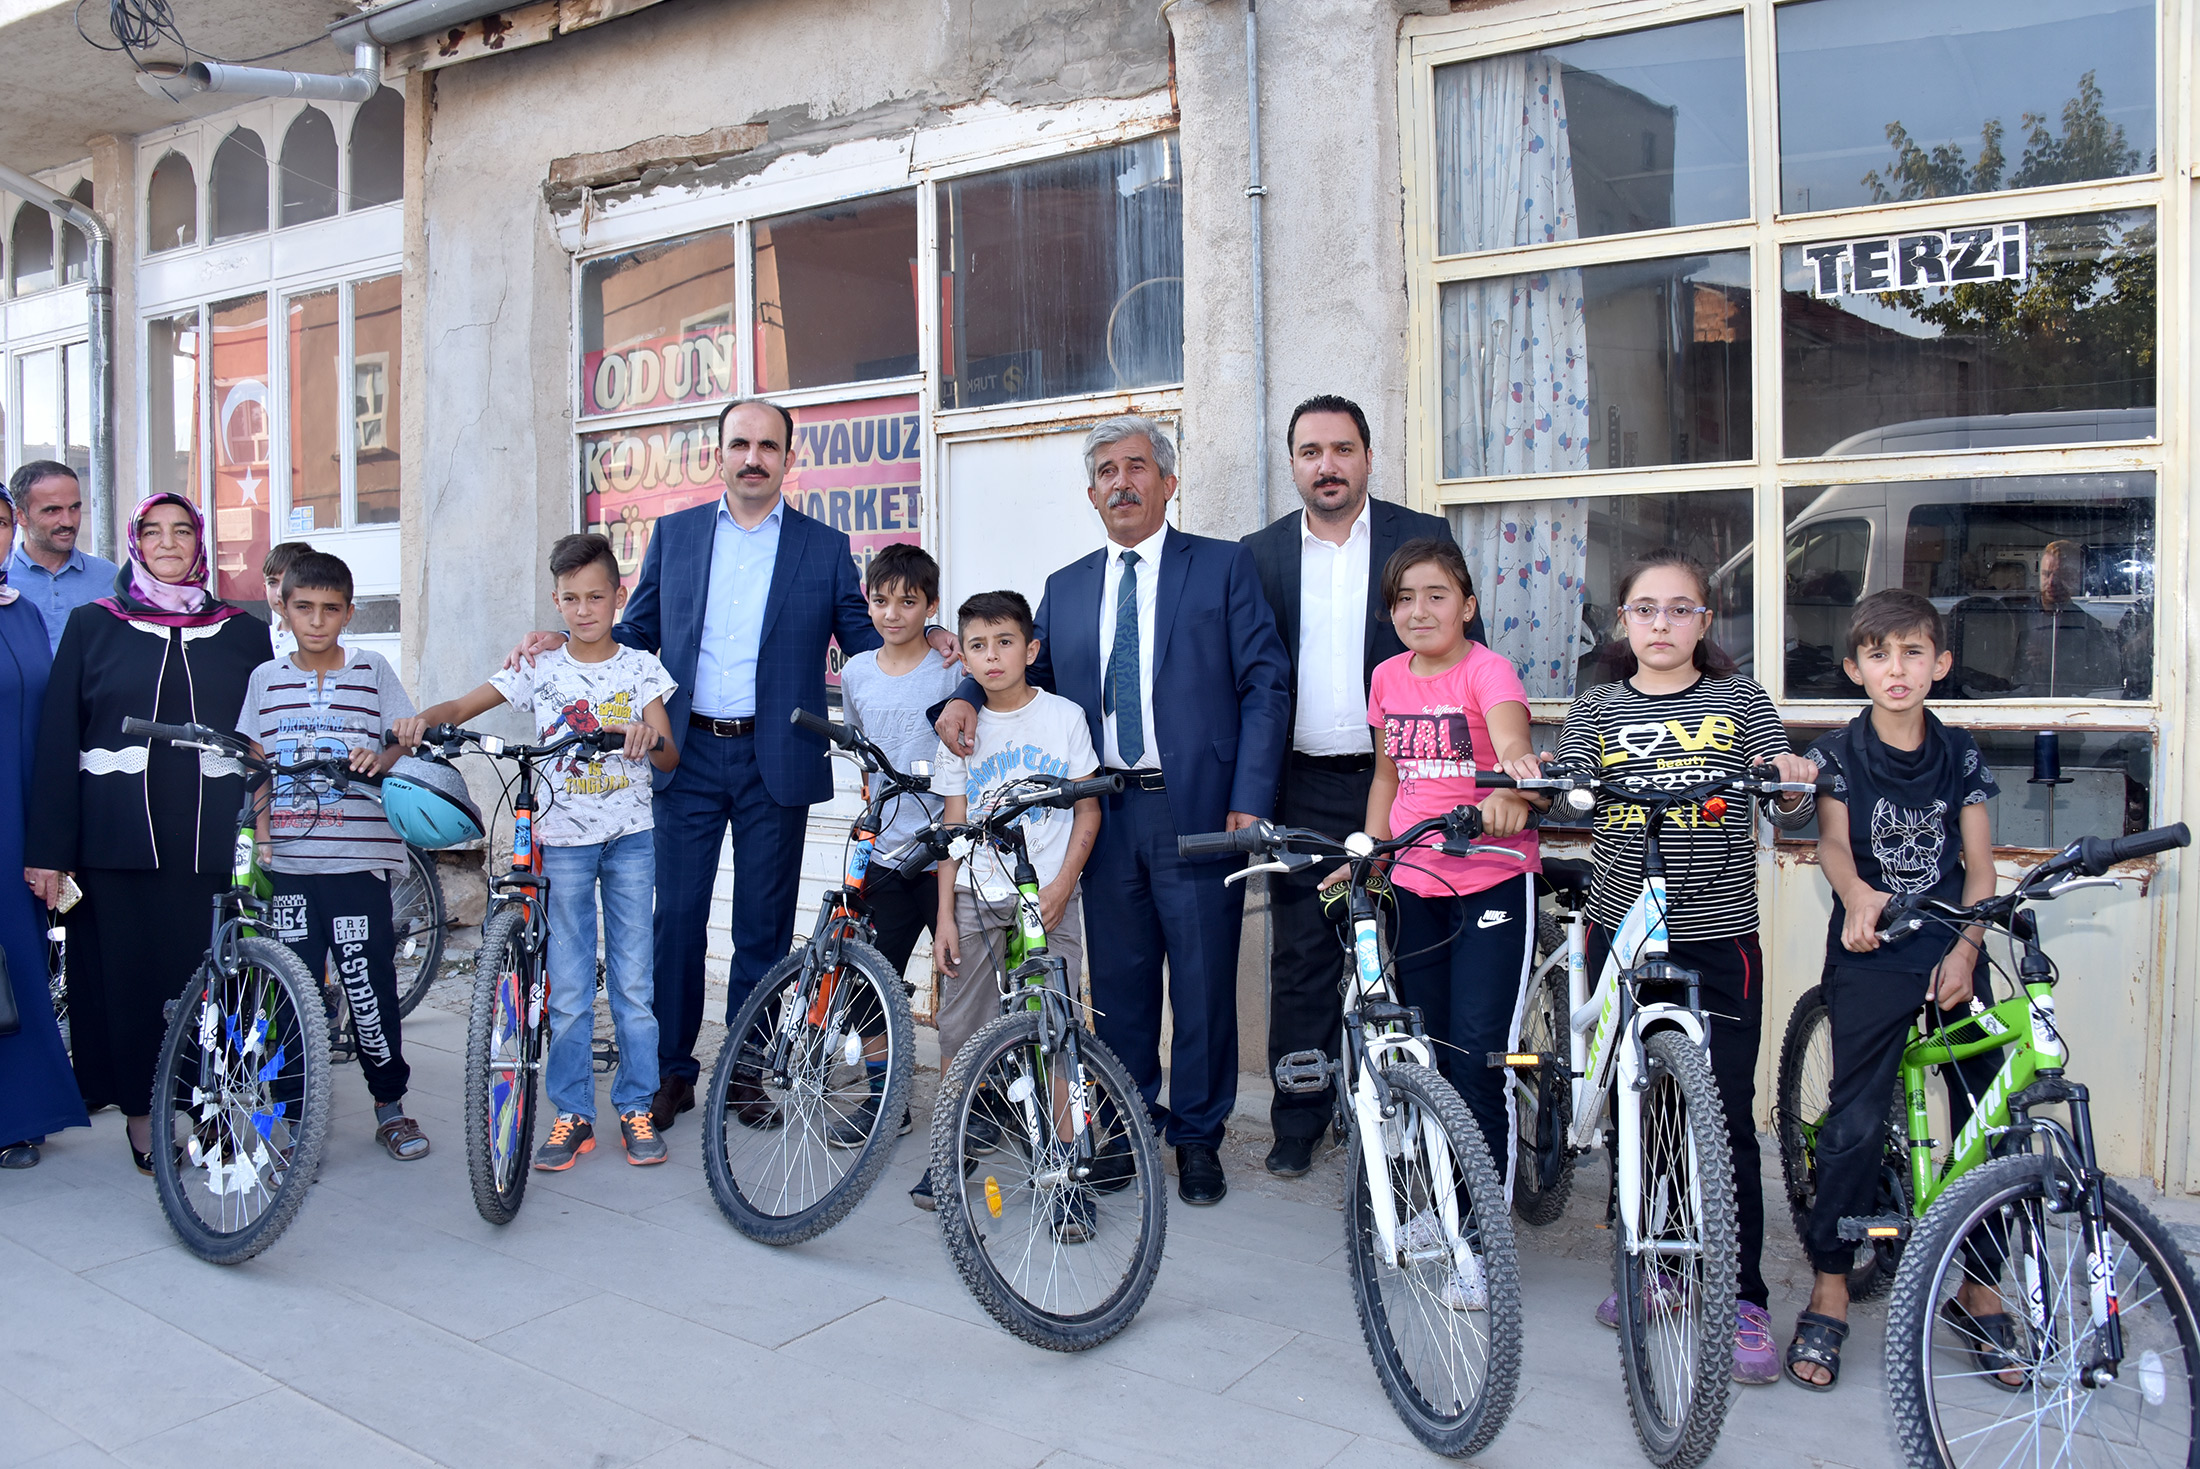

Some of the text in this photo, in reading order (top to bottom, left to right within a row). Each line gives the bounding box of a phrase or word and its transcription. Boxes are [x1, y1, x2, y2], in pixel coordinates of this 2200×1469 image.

[594, 332, 735, 411] ODUN
[615, 692, 630, 705] MY
[864, 707, 919, 738] NIKE
[1384, 719, 1460, 758] GIRL
[588, 761, 602, 776] IS
[1656, 755, 1707, 769] Beauty
[565, 775, 629, 794] TINGLING
[1482, 909, 1508, 921] NIKE
